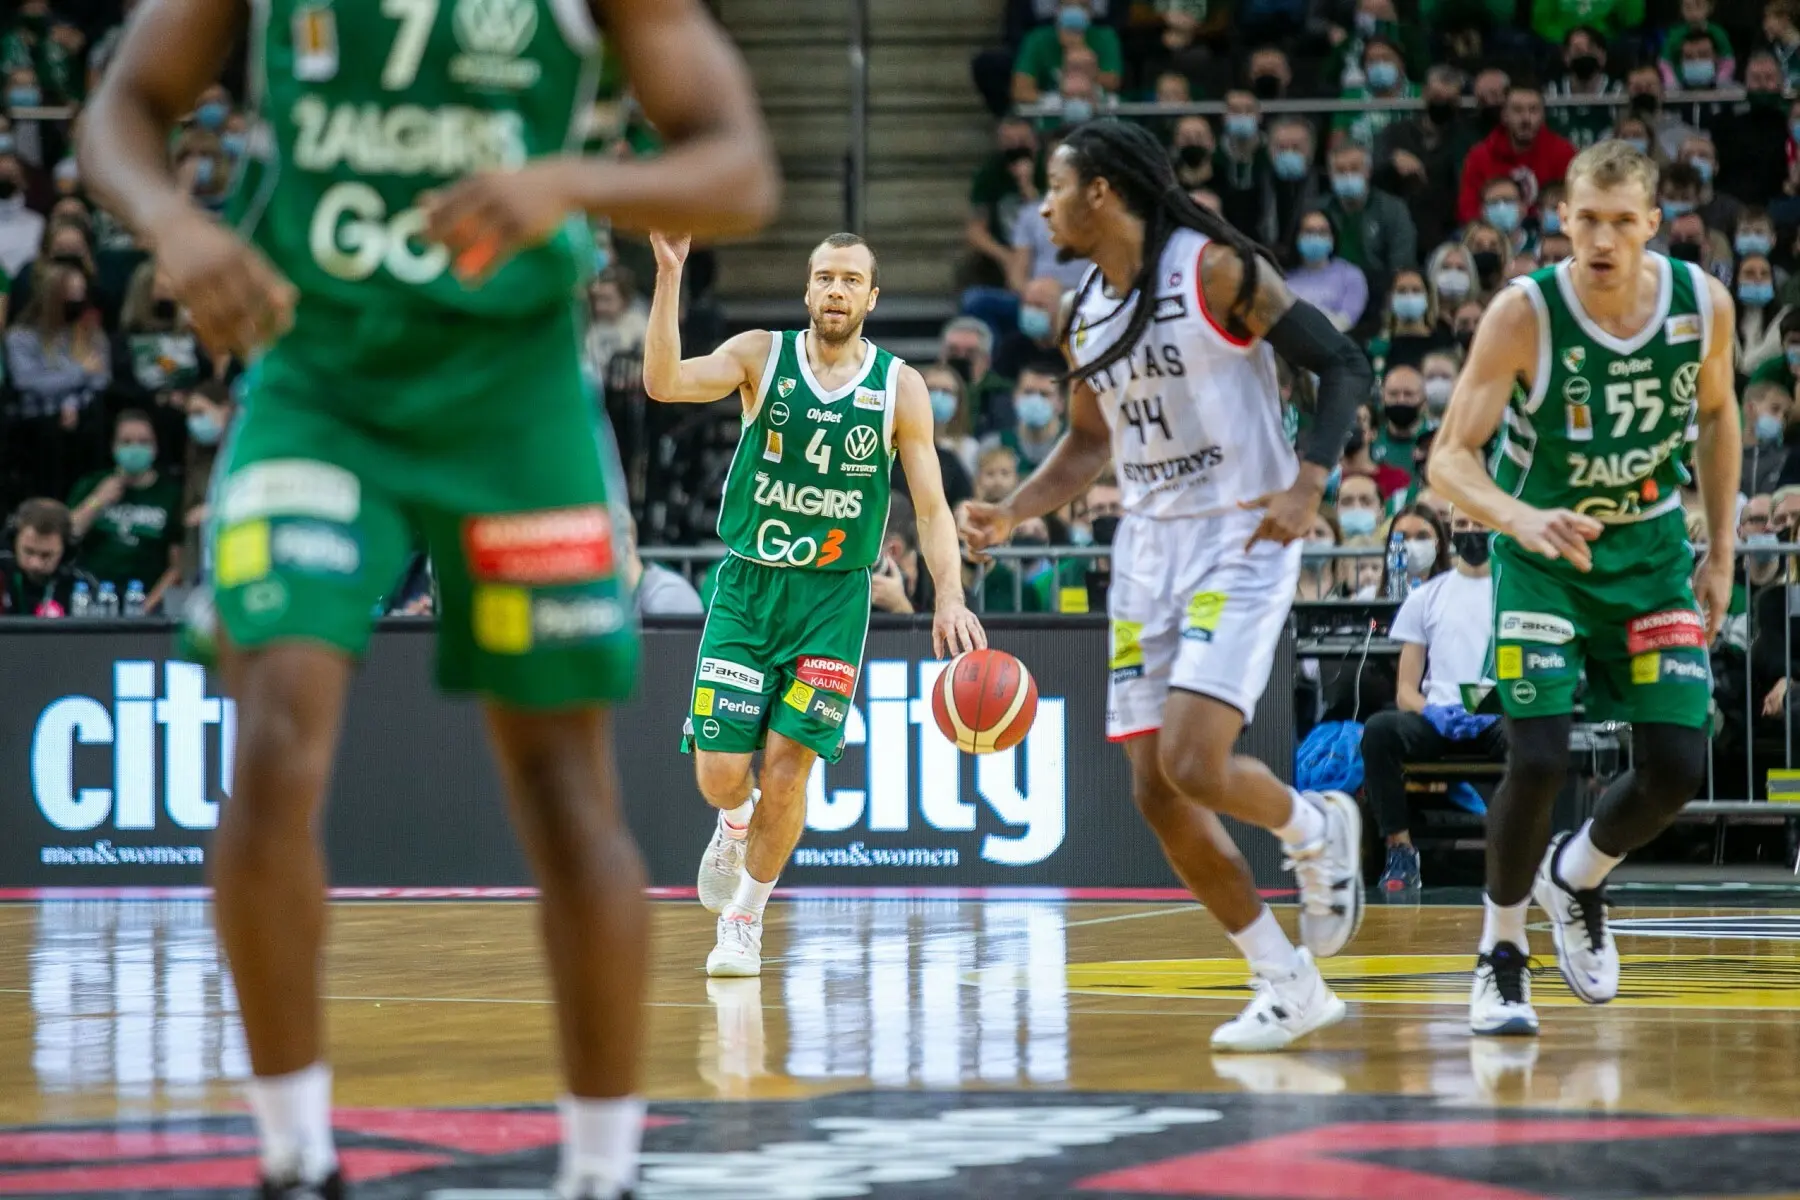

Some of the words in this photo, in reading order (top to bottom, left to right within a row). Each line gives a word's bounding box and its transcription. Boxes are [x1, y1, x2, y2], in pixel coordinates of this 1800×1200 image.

[381, 0, 440, 91] 7
[806, 408, 843, 424] OlyBet
[1120, 396, 1173, 445] 44
[1604, 378, 1665, 439] 55
[805, 428, 832, 475] 4
[754, 471, 863, 520] ŽALGIRIS
[715, 664, 760, 686] aksa
[810, 676, 847, 692] KAUNAS
[718, 697, 760, 715] Perlas
[814, 700, 844, 723] Perlas
[30, 659, 238, 831] cit
[794, 841, 960, 866] men&women
